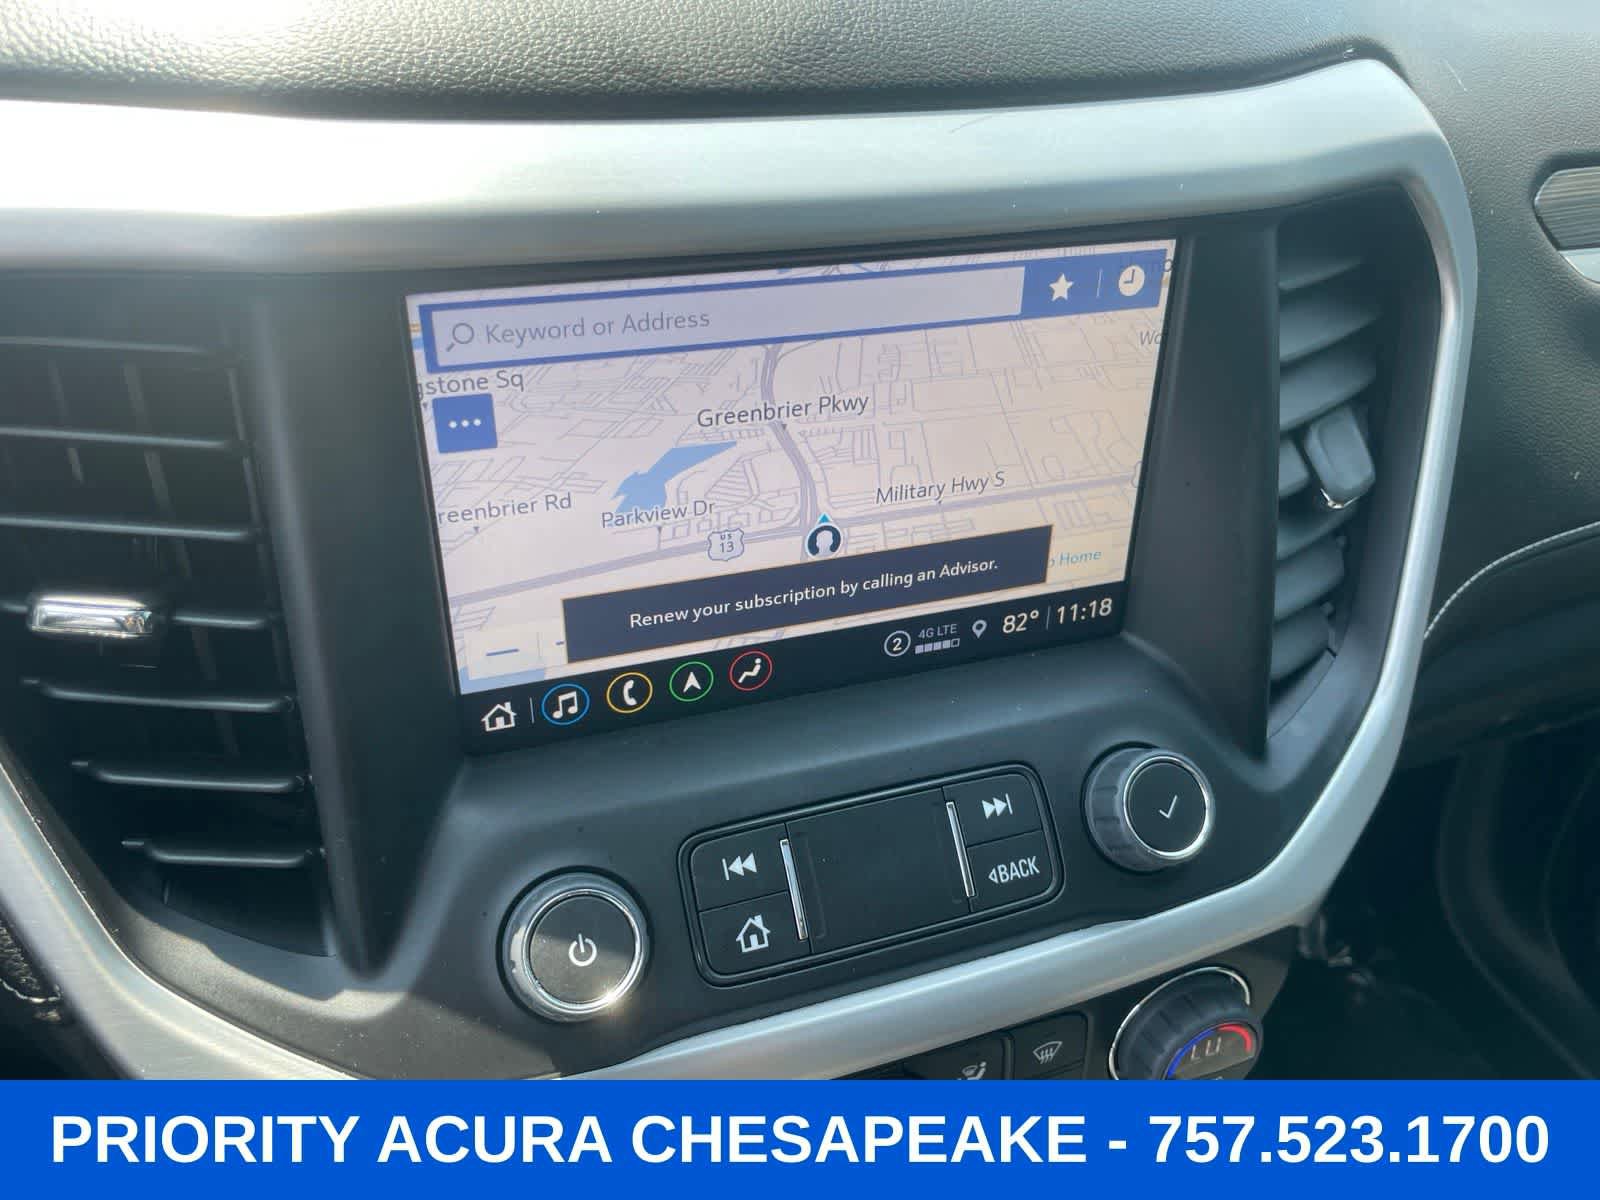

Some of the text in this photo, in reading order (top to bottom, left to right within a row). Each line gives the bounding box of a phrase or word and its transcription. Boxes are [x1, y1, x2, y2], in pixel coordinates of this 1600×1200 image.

[485, 311, 711, 349] Keyword or Address
[496, 369, 524, 392] Sq
[697, 394, 869, 428] Greenbrier Pkwy
[875, 470, 1005, 504] Military Hwy S
[545, 492, 572, 511] Rd
[601, 499, 715, 529] Parkview Dr
[720, 541, 735, 553] 13
[1059, 550, 1103, 568] Home
[630, 557, 998, 629] Renew your subscription by calling an Advisor.
[1056, 597, 1113, 625] 11:18
[917, 624, 958, 640] 4G LTE
[998, 856, 1041, 883] BACK
